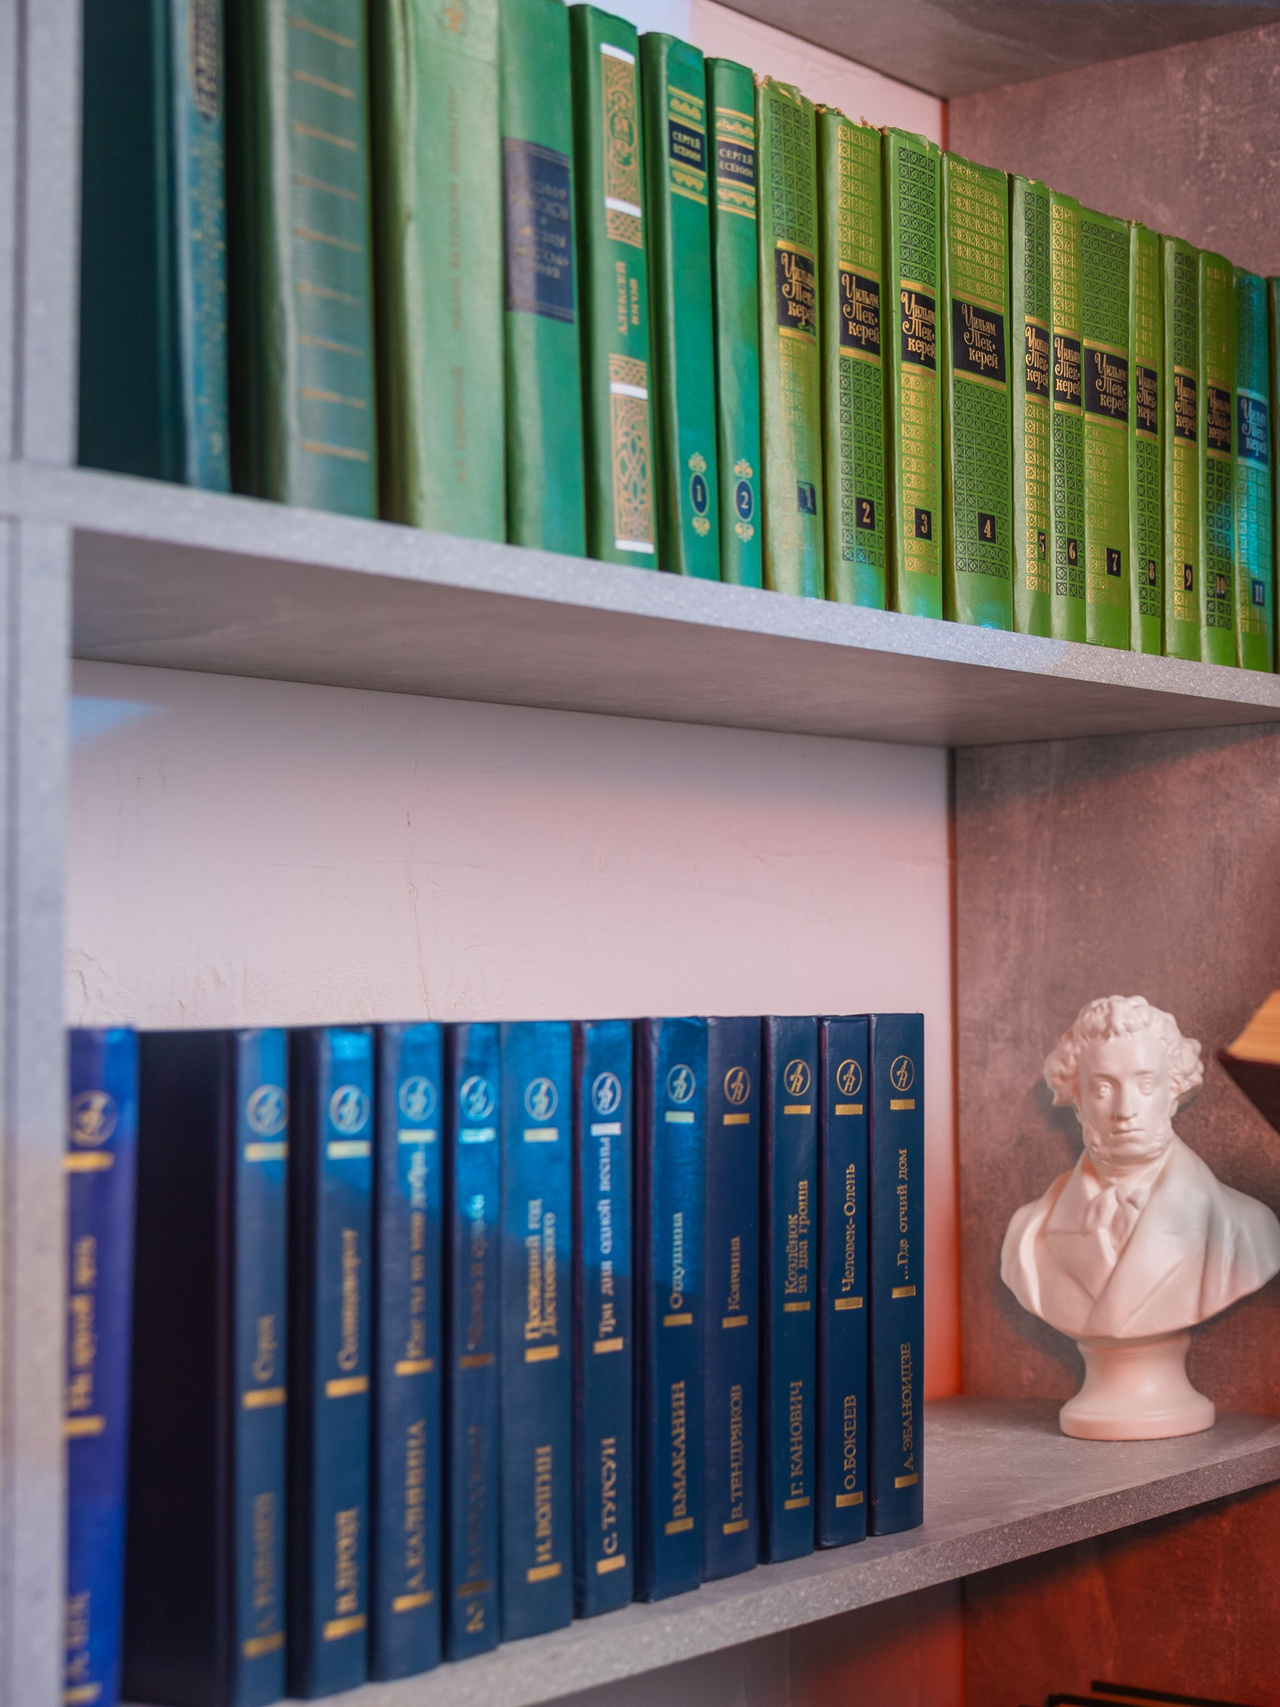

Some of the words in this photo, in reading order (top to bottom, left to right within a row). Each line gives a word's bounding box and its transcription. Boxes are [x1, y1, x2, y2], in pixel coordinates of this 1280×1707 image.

[672, 130, 701, 151] СЕРГЕЙ
[673, 143, 701, 163] ЕСЕНИН
[719, 148, 754, 166] СЕРГЕЙ
[720, 160, 754, 178] ЕСЕНИН
[848, 321, 880, 345] керей
[968, 347, 999, 371] керей
[1100, 394, 1128, 415] керей
[695, 484, 703, 502] 1
[740, 490, 749, 510] 2
[805, 484, 814, 510] 1
[862, 501, 871, 524] 2
[920, 513, 928, 534] 3
[983, 518, 992, 538] 4
[1039, 533, 1046, 554] 5
[1068, 542, 1076, 560] 6
[1111, 553, 1119, 572] 7
[1149, 561, 1155, 580] 8
[1185, 568, 1192, 587] 9
[1255, 584, 1263, 604] 11
[599, 1136, 612, 1191] весны
[898, 1148, 909, 1180] дом
[527, 1198, 543, 1230] год
[798, 1180, 811, 1235] гроша
[896, 1183, 909, 1233] отчий
[597, 1198, 613, 1255] одной
[841, 1162, 856, 1292] Человек-Олень
[668, 1211, 686, 1310] Отдушина
[784, 1213, 799, 1295] Козлёнок
[798, 1245, 810, 1270] два
[897, 1238, 910, 1281] ...Где
[541, 1212, 557, 1337] Достоевского
[600, 1260, 615, 1296] дня
[727, 1235, 741, 1311] Кончина
[524, 1234, 543, 1341] Последний
[798, 1281, 808, 1294] за
[599, 1303, 617, 1338] Три
[900, 1341, 914, 1452] ЭБАНОИДЗЕ
[790, 1380, 804, 1479] КАНОВИЧ
[843, 1394, 857, 1490] О.БОКЕЕВ
[730, 1384, 744, 1501] ТЕНДРЯКОВ
[902, 1453, 914, 1471] А.
[601, 1436, 617, 1531] ТУРСУН
[791, 1481, 804, 1497] Г.
[466, 1601, 485, 1634] 2
